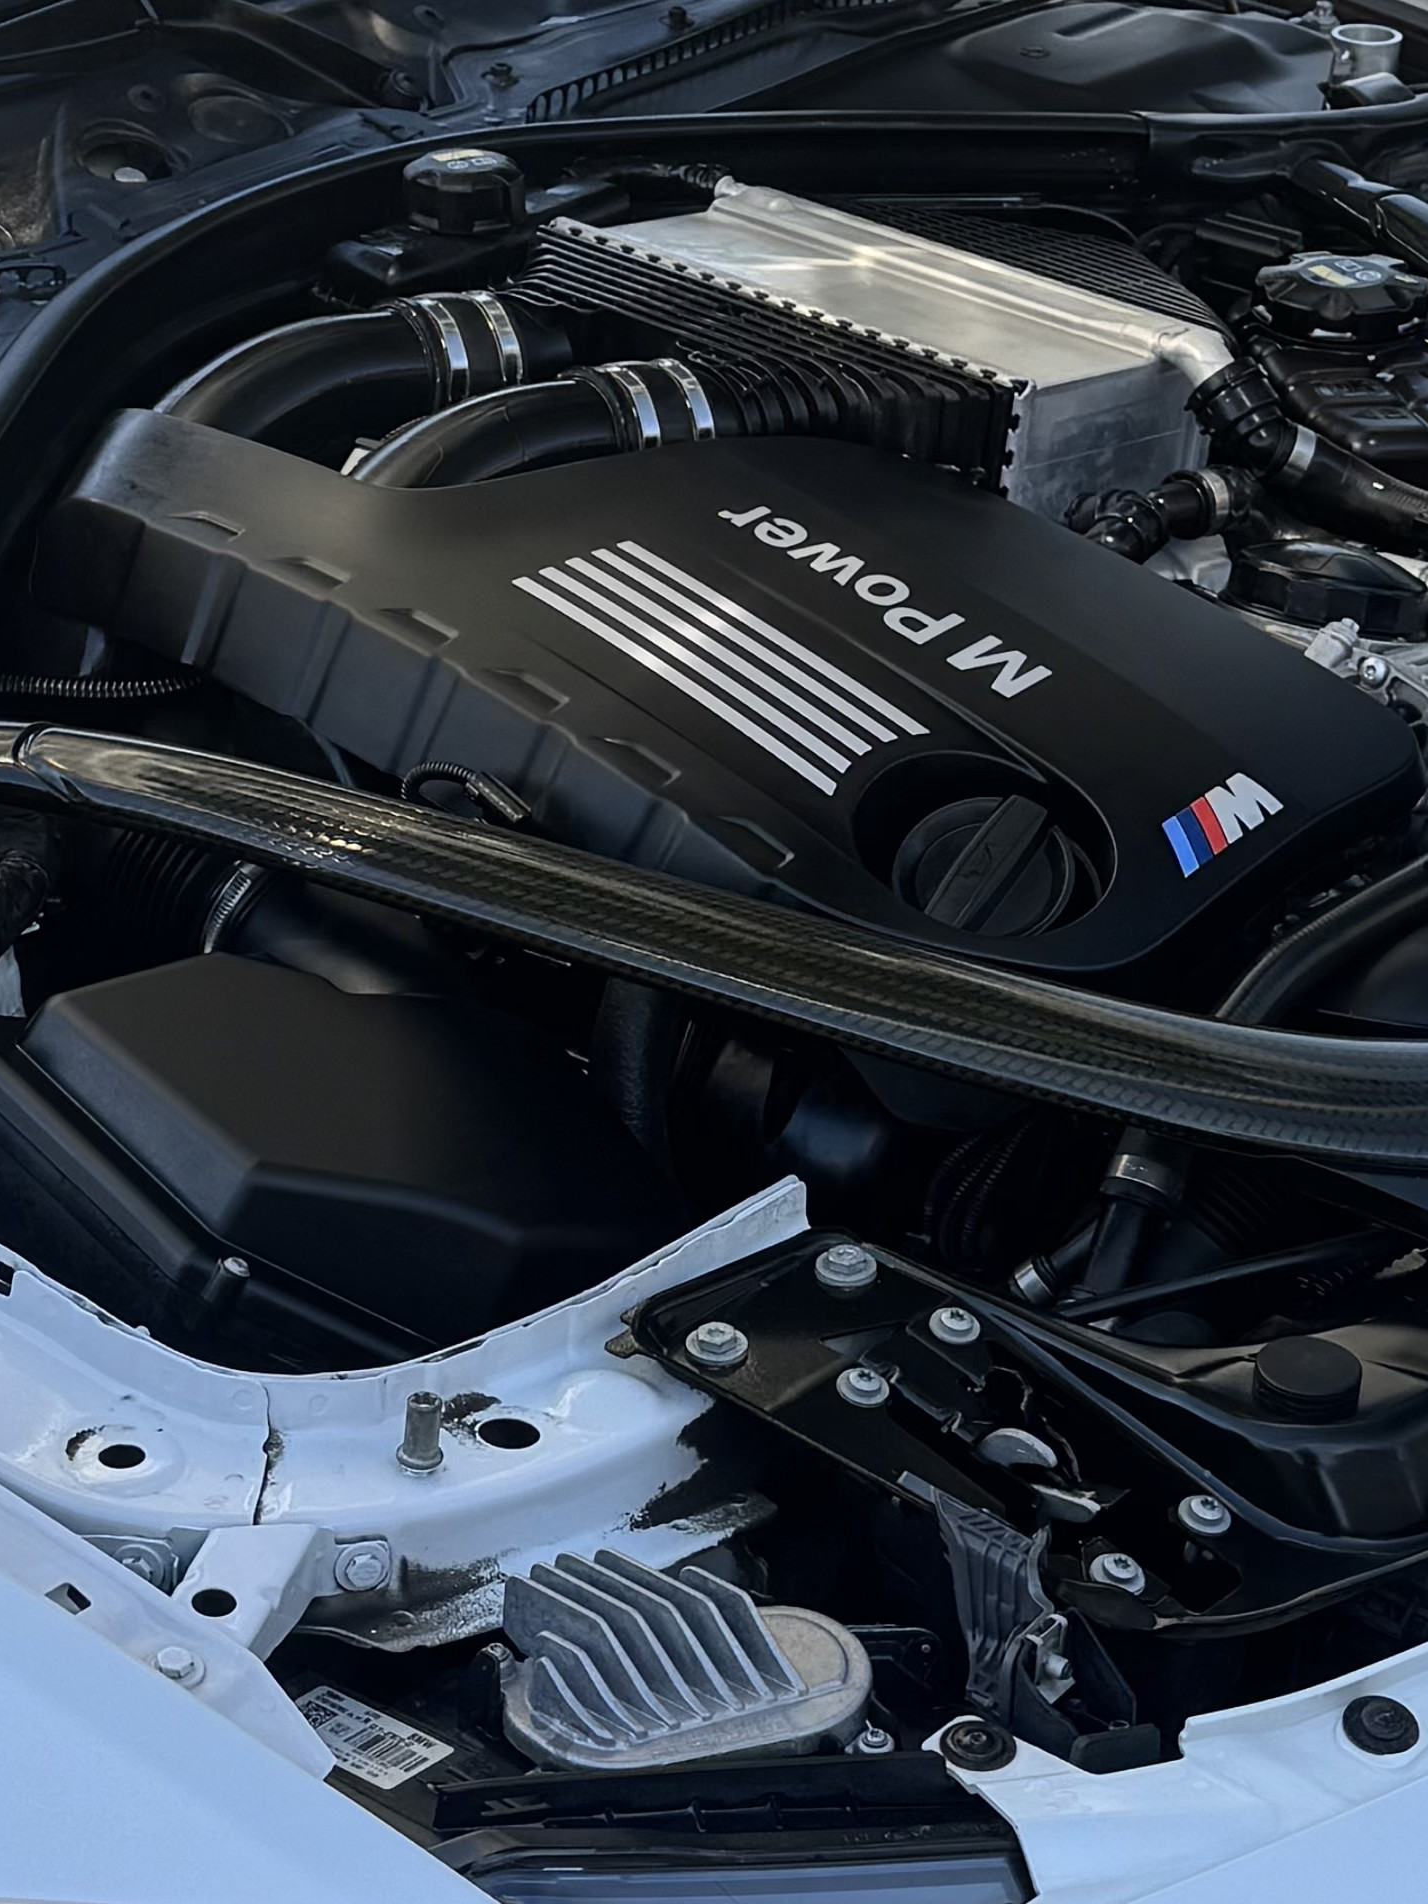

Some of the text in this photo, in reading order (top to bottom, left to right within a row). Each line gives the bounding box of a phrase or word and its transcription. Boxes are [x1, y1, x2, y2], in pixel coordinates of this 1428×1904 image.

[717, 504, 1053, 699] M Power
[407, 1733, 437, 1749] BMW
